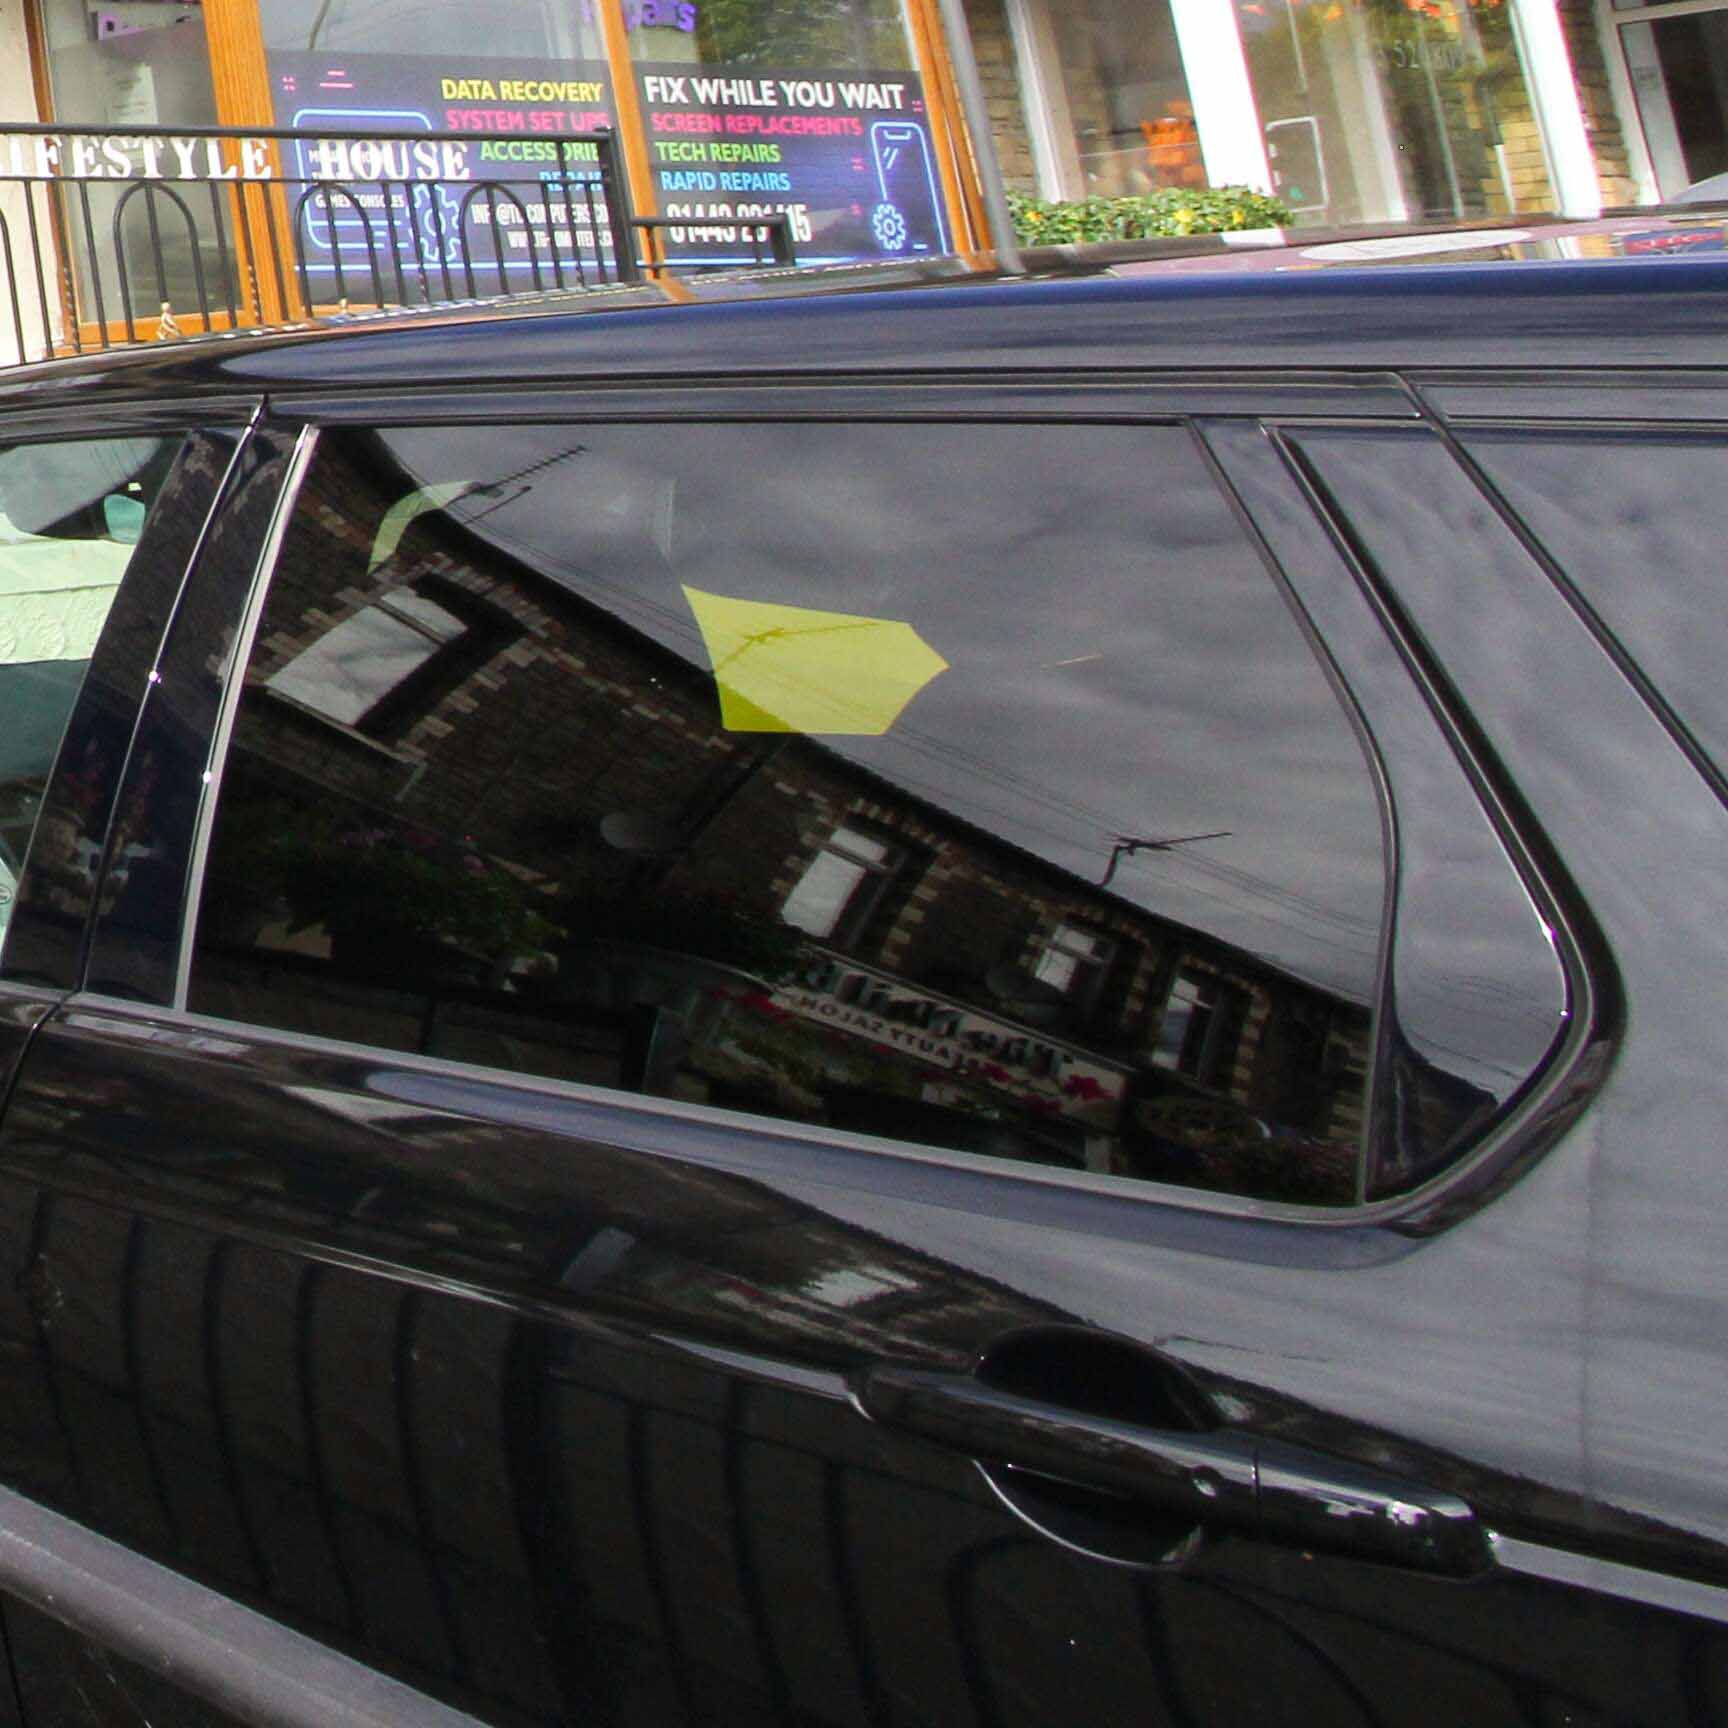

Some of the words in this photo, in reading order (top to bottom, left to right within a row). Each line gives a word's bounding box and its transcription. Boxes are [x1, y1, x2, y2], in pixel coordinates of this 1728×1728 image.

[441, 78, 496, 101] DATA
[499, 80, 604, 103] RECOVERY
[644, 75, 689, 105] FIX
[691, 77, 777, 107] WHILE
[779, 80, 835, 108] YOU
[838, 82, 904, 110] WAIT
[446, 108, 525, 130] SYSTEM
[528, 110, 566, 131] SET
[651, 112, 722, 133] SCREEN
[726, 115, 864, 136] REPLACEMENTS
[312, 138, 470, 181] HOUSE
[655, 141, 706, 163] TECH
[710, 142, 782, 163] REPAIRS
[660, 170, 717, 192] RAPID
[720, 171, 791, 192] REPAIRS
